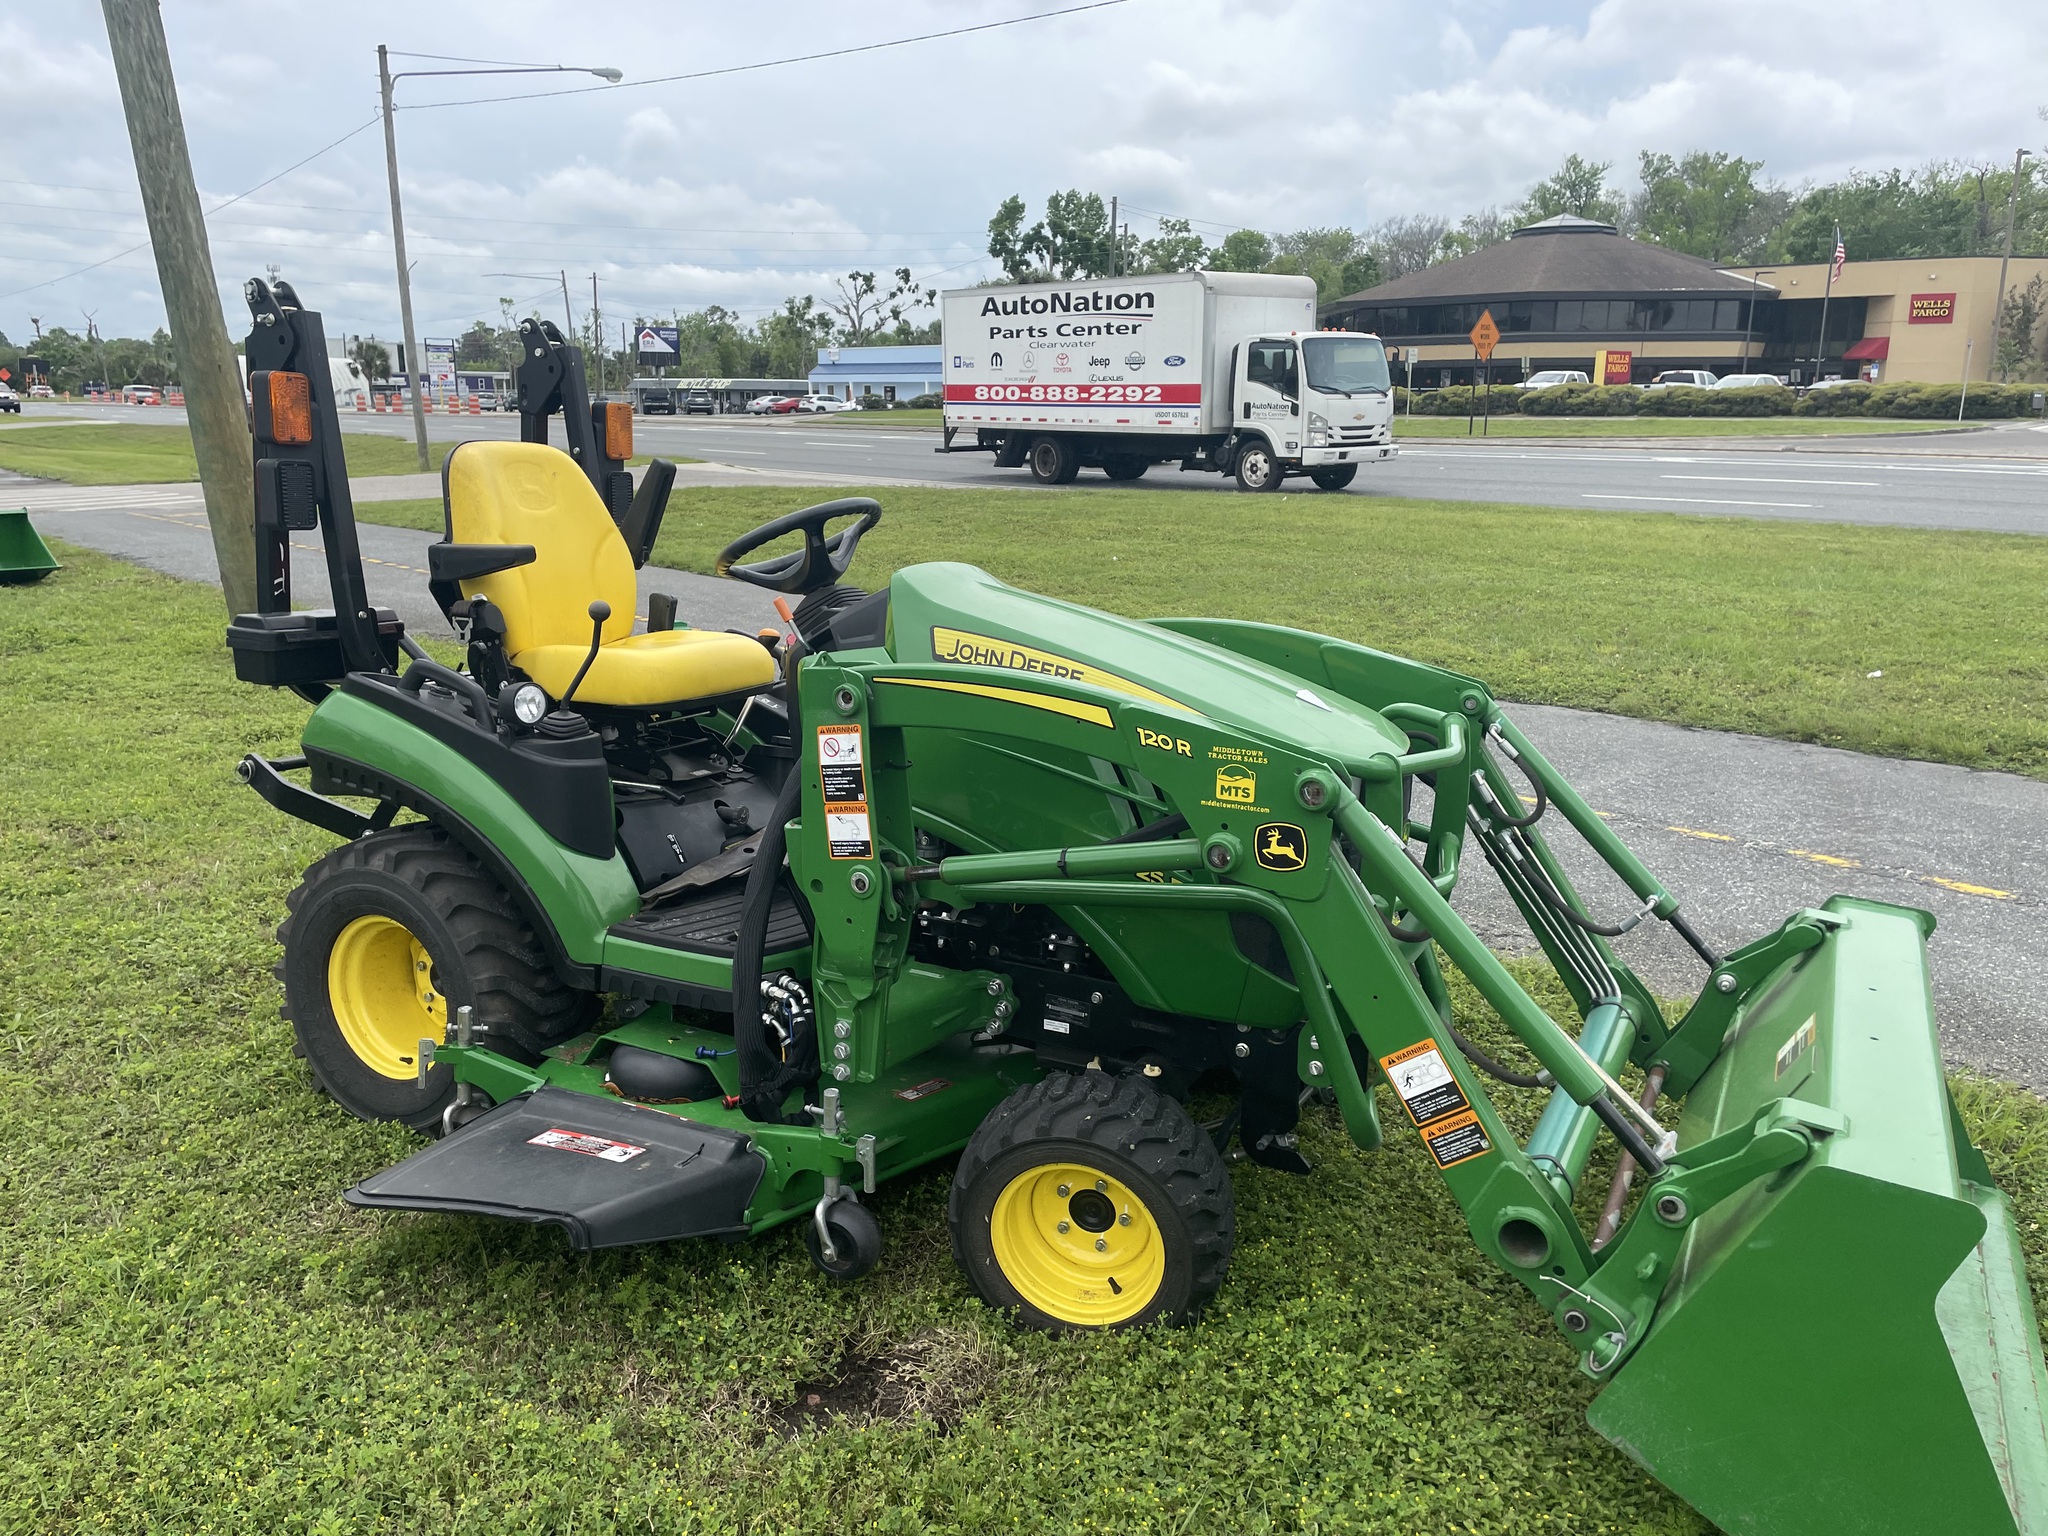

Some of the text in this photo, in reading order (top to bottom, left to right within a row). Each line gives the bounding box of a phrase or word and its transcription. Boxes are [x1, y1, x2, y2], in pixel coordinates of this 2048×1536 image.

[981, 291, 1154, 317] AutoNation
[1913, 300, 1950, 308] WELLS
[1912, 308, 1948, 317] FARGO
[990, 322, 1142, 339] Parts Center
[1029, 340, 1096, 349] Clearwater
[1089, 356, 1110, 368] Jeep
[1607, 354, 1629, 363] WELLS
[962, 361, 974, 369] Parts
[1607, 364, 1628, 373] FARGO
[974, 386, 1162, 402] 800-888-2292
[1252, 402, 1289, 410] AutoNation
[947, 639, 1005, 667] JOHN
[826, 725, 859, 734] WARNING
[1213, 746, 1263, 757] MIDDLETOWN
[1208, 752, 1269, 765] TRACTOR SALES
[1220, 784, 1250, 799] MTS
[833, 805, 866, 813] WARNING
[1200, 800, 1270, 814] middletowntractor.com
[1395, 1043, 1430, 1062] WARNING
[1436, 1115, 1472, 1134] WARNING
